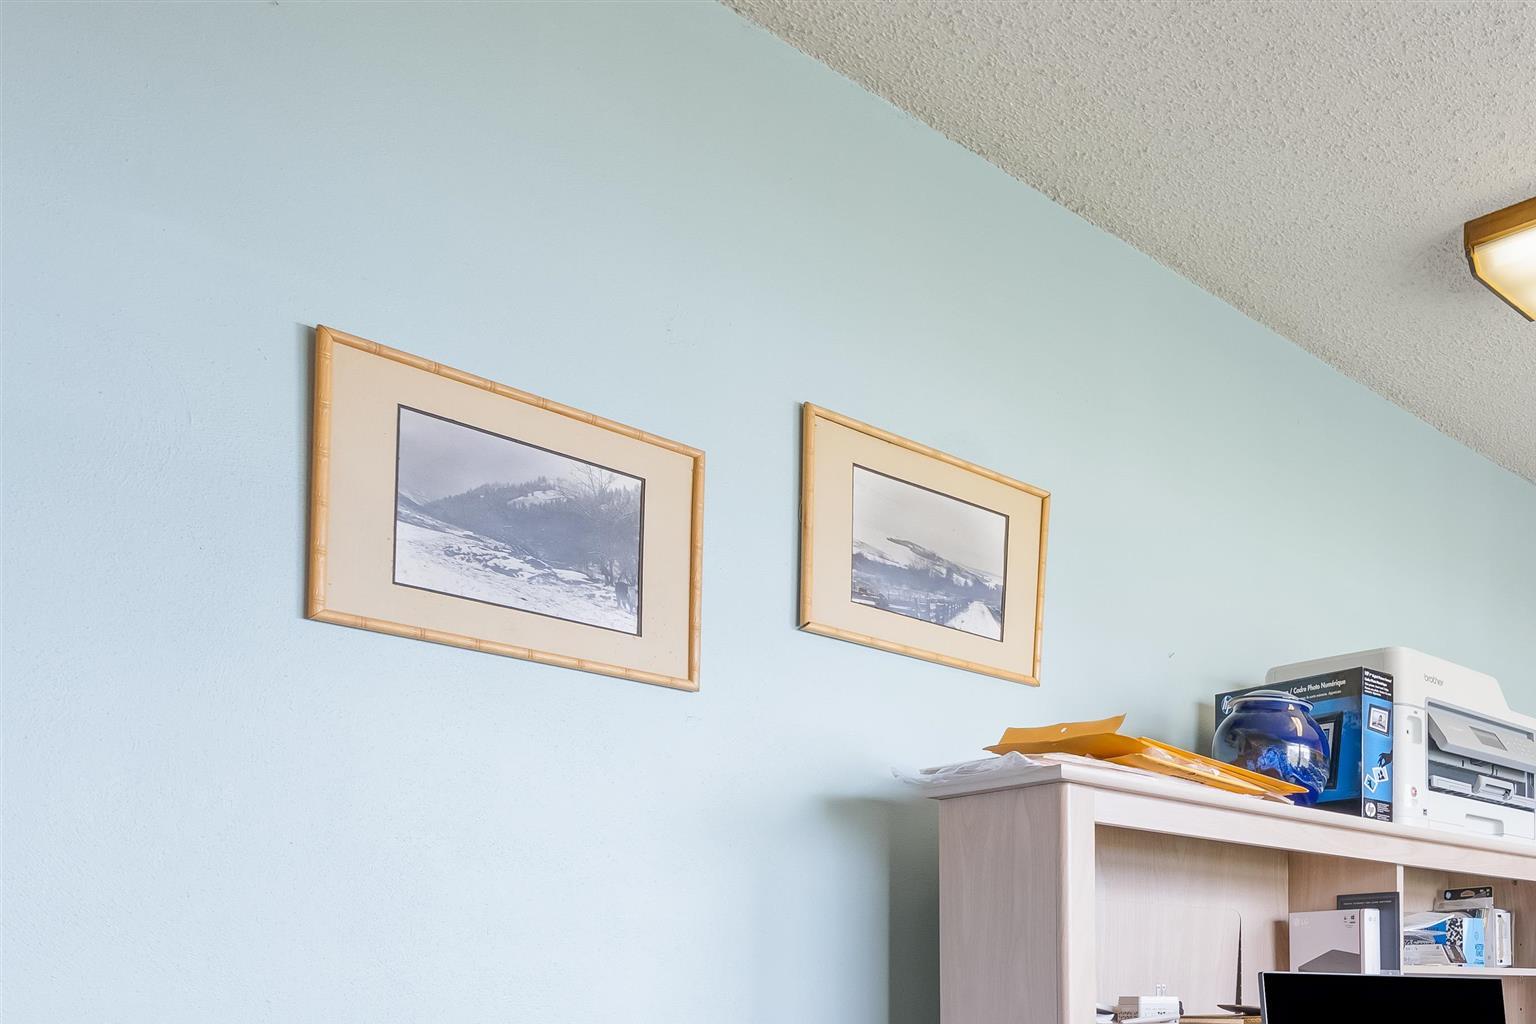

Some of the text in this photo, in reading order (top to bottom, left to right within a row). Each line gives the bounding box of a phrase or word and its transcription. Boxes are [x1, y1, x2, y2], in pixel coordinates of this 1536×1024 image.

[1424, 674, 1444, 686] brother
[1293, 686, 1307, 694] Cadre
[1308, 682, 1320, 692] Photo
